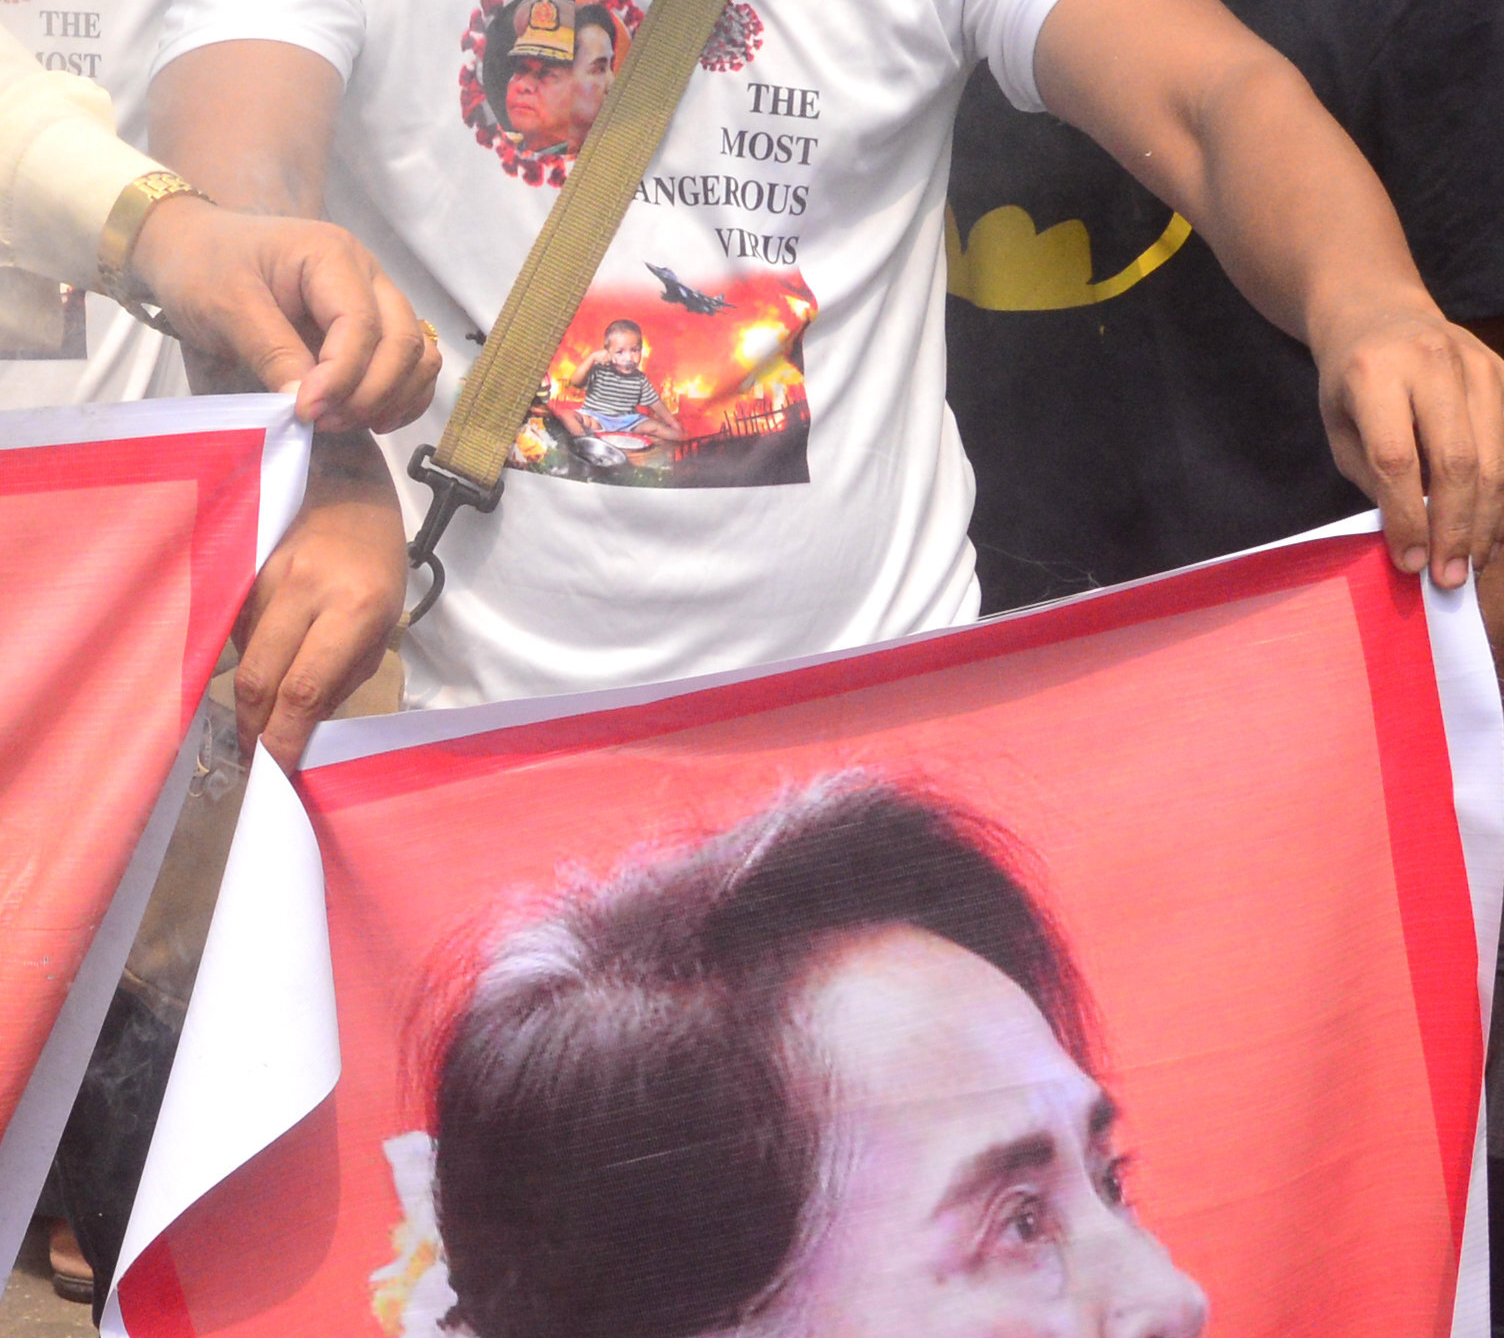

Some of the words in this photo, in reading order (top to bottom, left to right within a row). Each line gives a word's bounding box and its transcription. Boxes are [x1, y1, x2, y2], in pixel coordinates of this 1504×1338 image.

[39, 10, 102, 39] THE
[747, 82, 821, 120] THE
[720, 127, 819, 165] MOST
[714, 227, 800, 265] VIRUS
